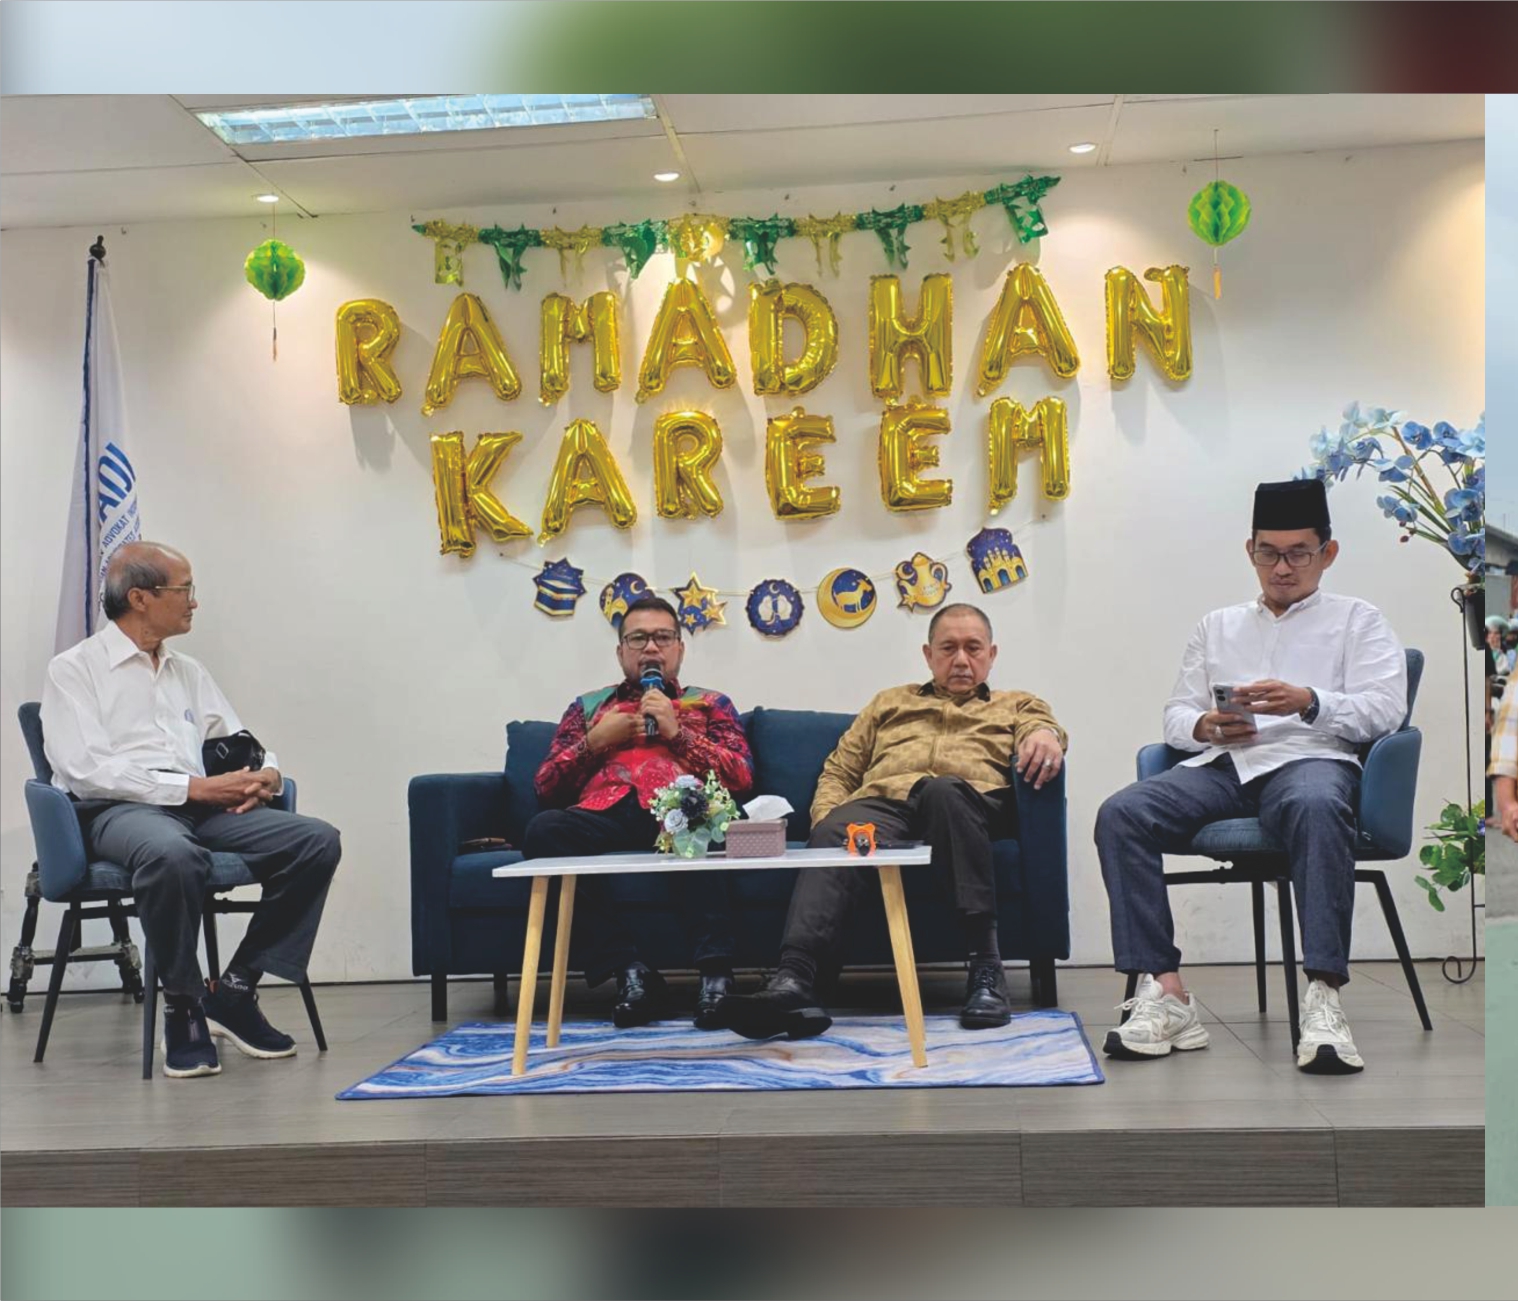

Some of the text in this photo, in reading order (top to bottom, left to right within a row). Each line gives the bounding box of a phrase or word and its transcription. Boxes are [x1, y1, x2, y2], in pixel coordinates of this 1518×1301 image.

[335, 261, 1193, 416] RAMADHAN
[102, 514, 130, 549] ADVOKAT
[430, 396, 1072, 558] KAREEM
